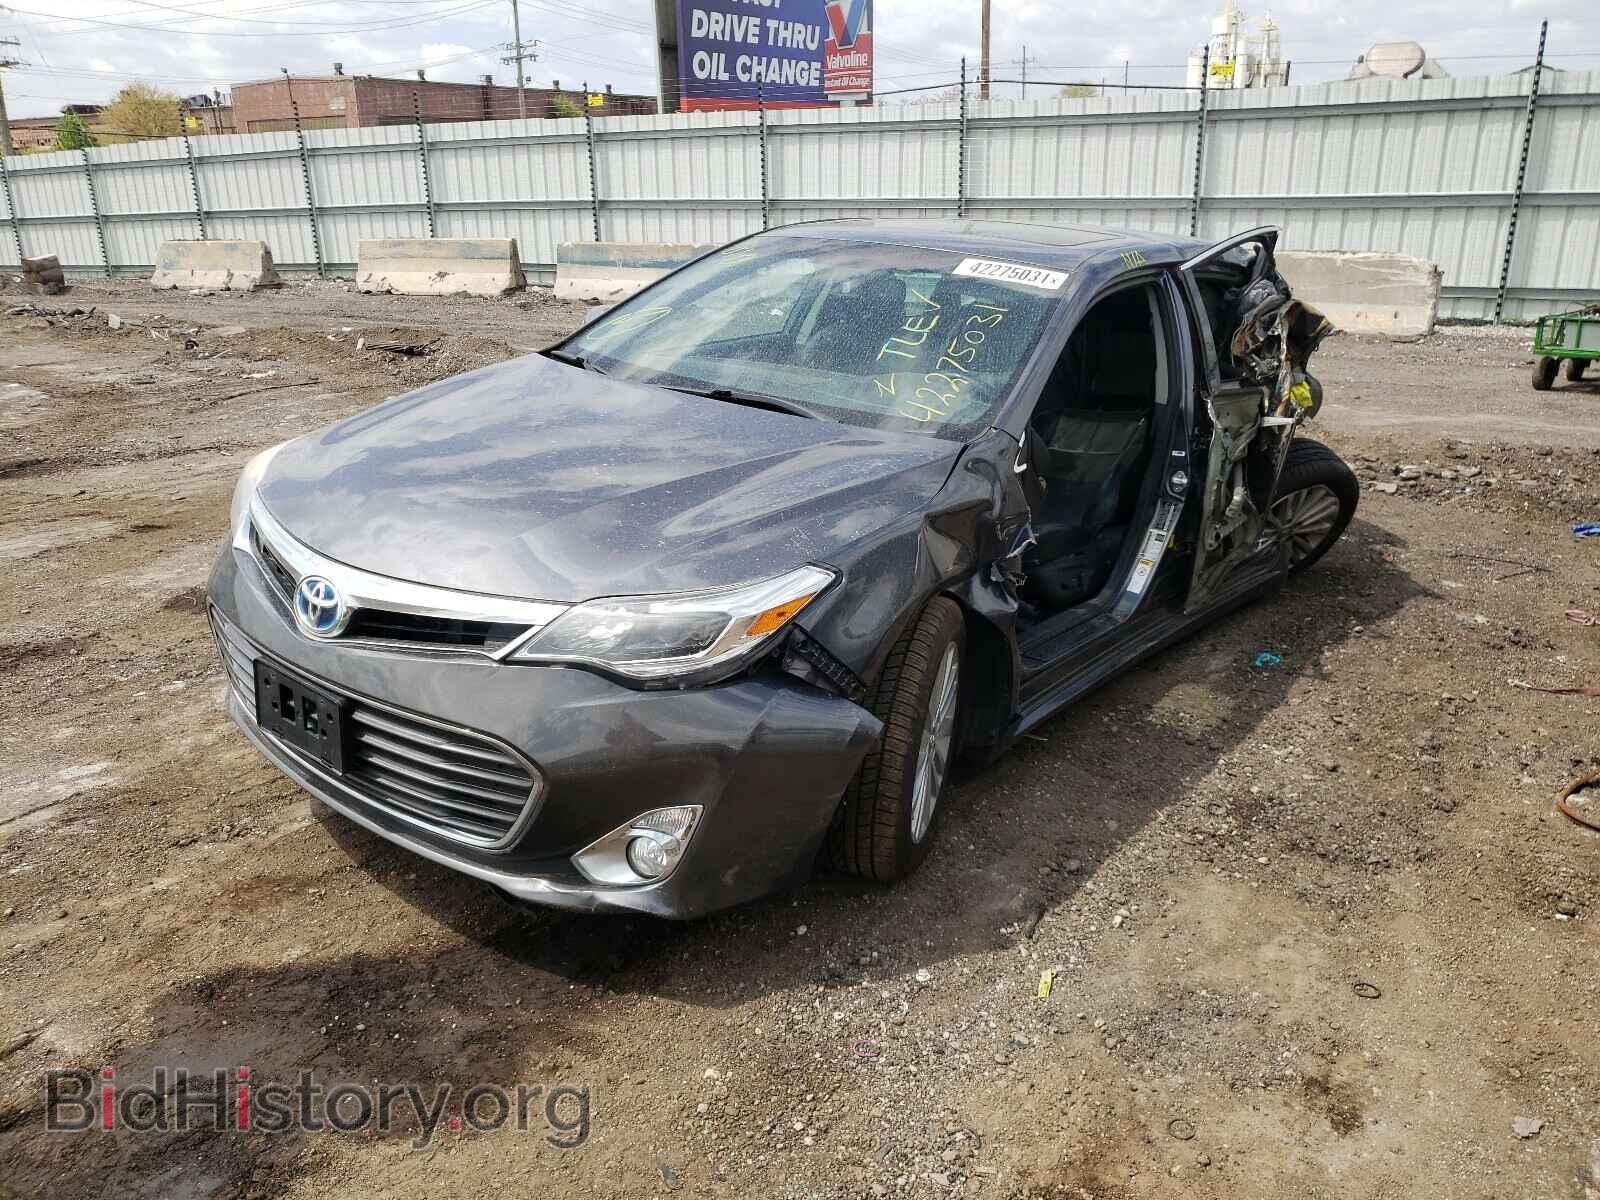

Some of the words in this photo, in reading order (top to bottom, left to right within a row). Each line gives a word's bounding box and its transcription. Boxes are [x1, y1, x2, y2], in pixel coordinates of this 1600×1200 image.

[691, 9, 760, 44] DRIVE
[766, 19, 820, 51] THRU
[693, 51, 729, 81] OIL
[735, 54, 821, 87] CHANGE
[826, 50, 868, 70] Valvoline
[899, 304, 1009, 422] 42275031
